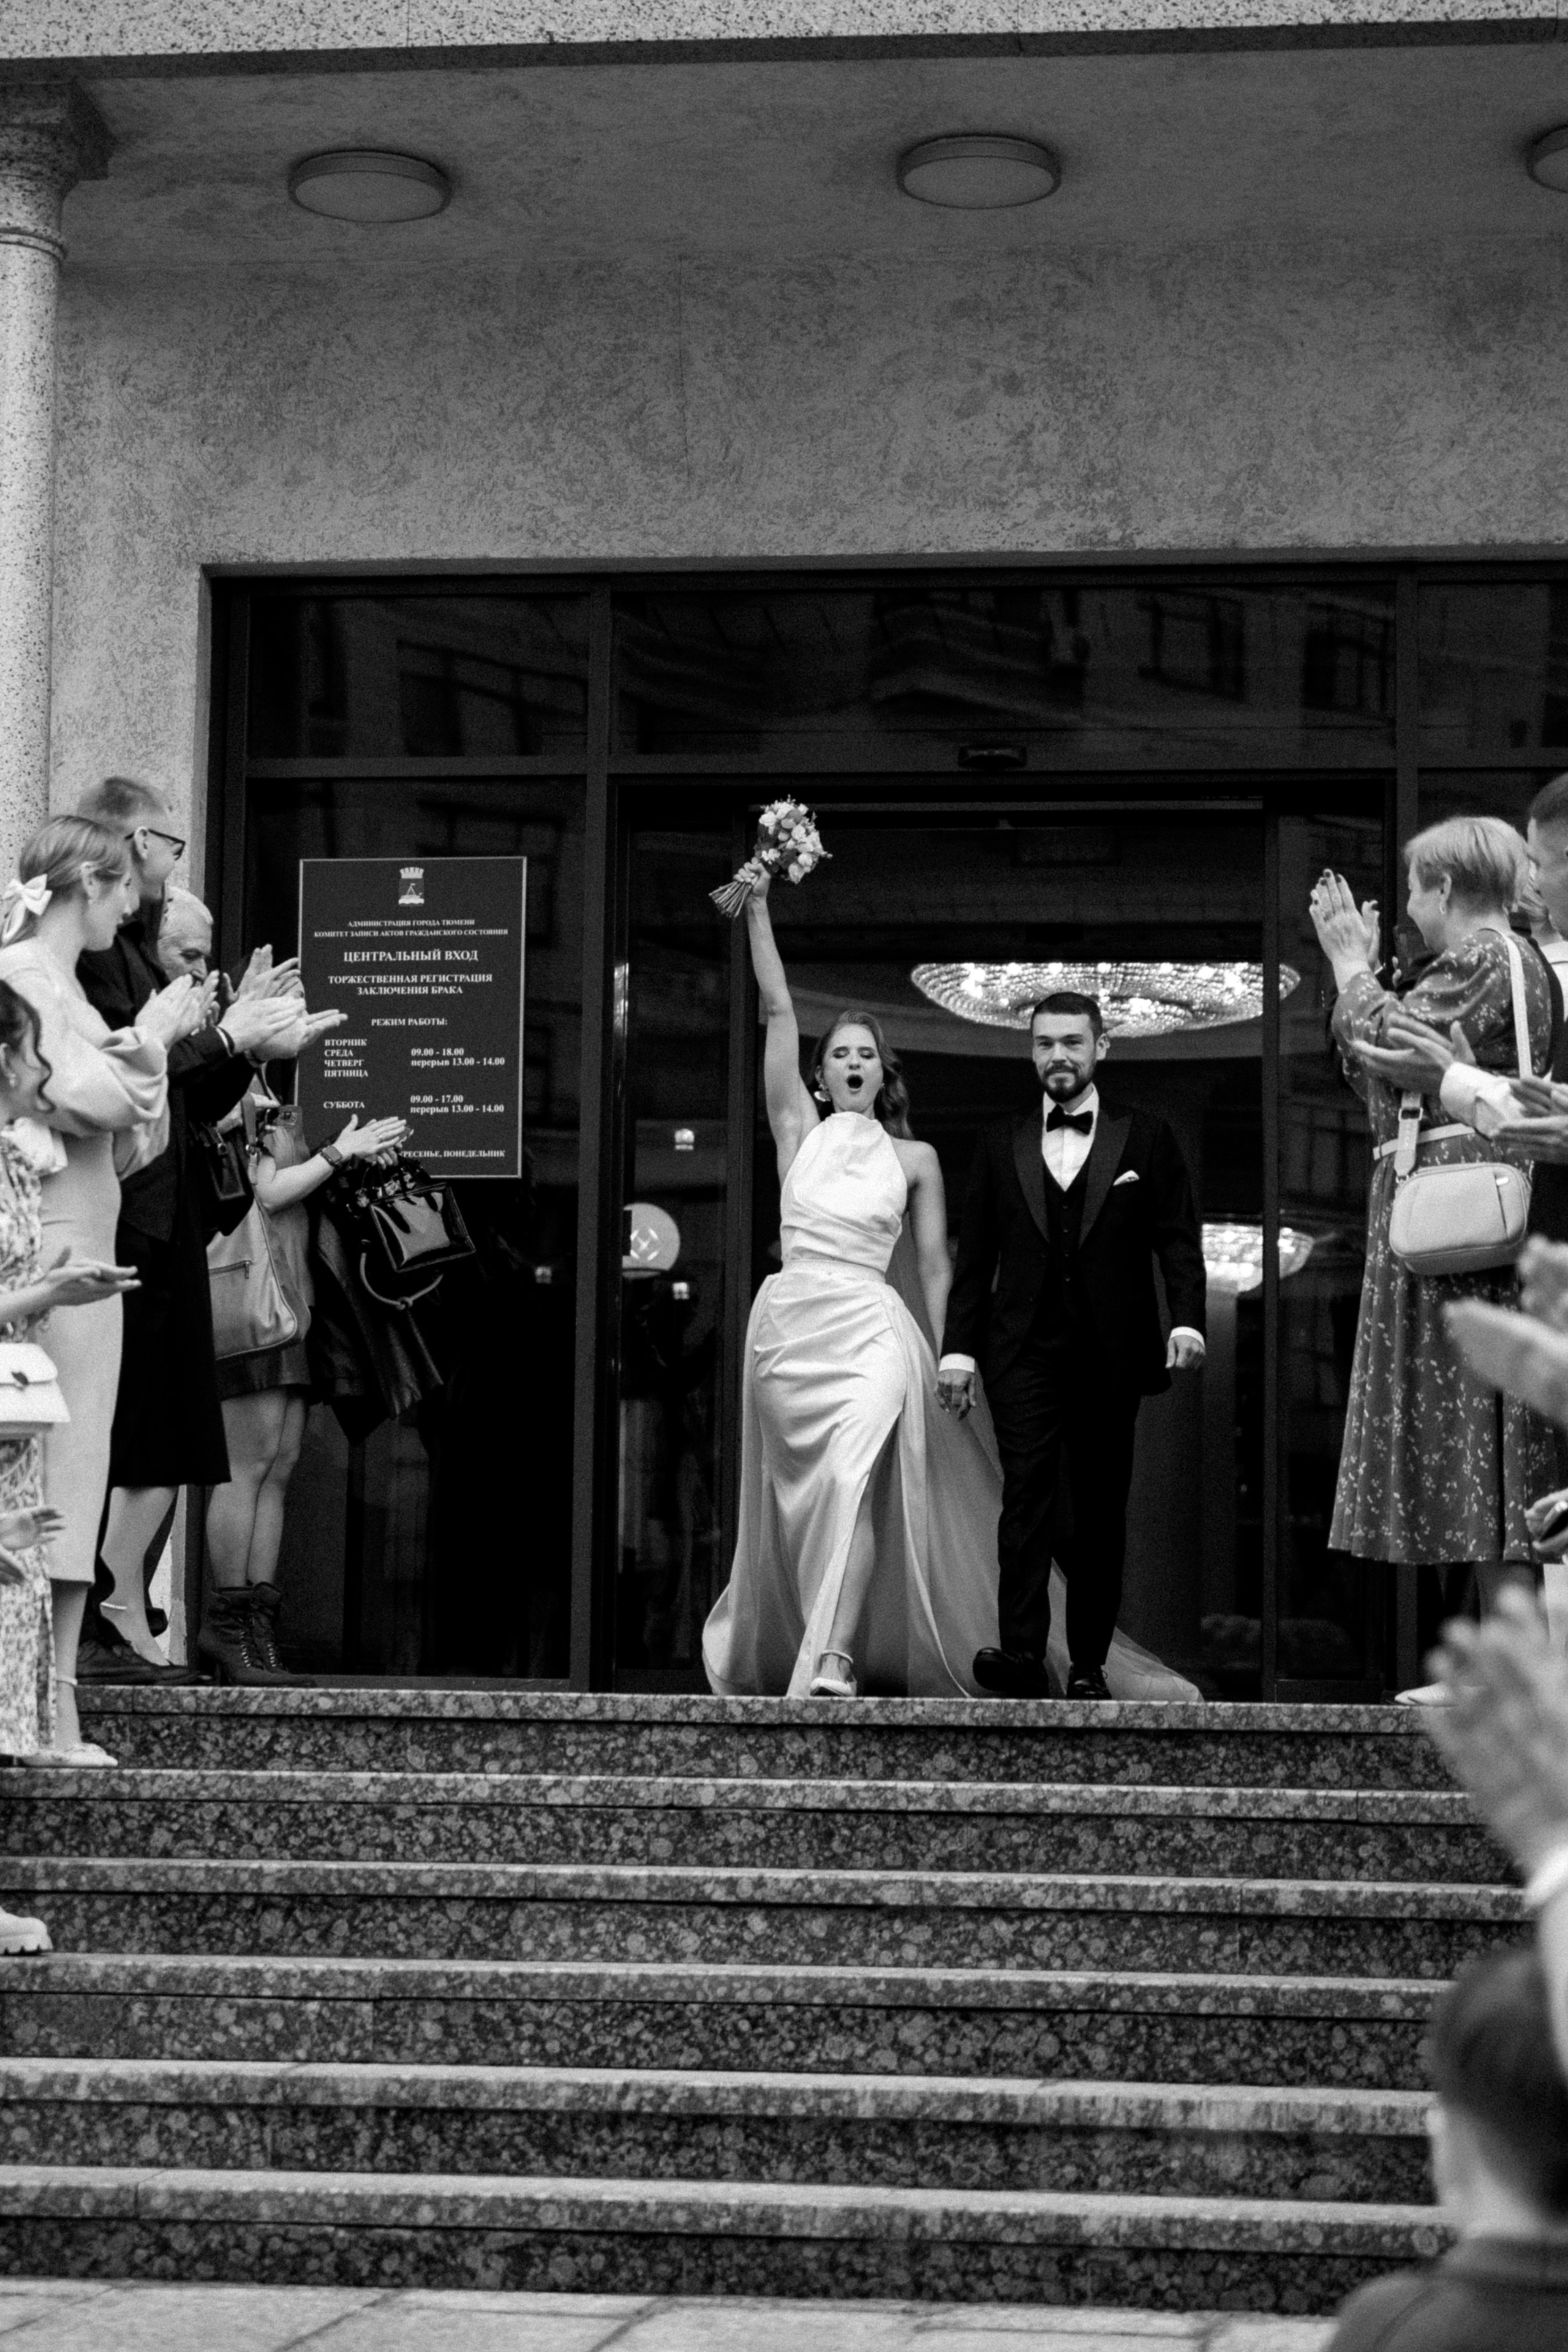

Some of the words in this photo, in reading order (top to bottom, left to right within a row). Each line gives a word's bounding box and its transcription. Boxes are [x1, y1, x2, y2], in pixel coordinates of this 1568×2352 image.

[344, 949, 441, 963] ЦЕНТРАЛЬНЫЙ
[445, 950, 478, 961] ВХОД
[328, 974, 418, 984] ТОРЖЕСТВЕННАЯ
[420, 974, 492, 982] РЕГИСТРАЦИЯ
[358, 986, 428, 995] ЗАКЛЮЧЕНИЯ
[442, 1047, 464, 1056] 18.00
[411, 1060, 450, 1068] перерыв
[453, 1057, 475, 1066] 13.00
[483, 1057, 505, 1066] 14.00
[442, 1095, 464, 1103] 17.00
[410, 1106, 449, 1115] перерыв
[452, 1104, 474, 1113] 13.00
